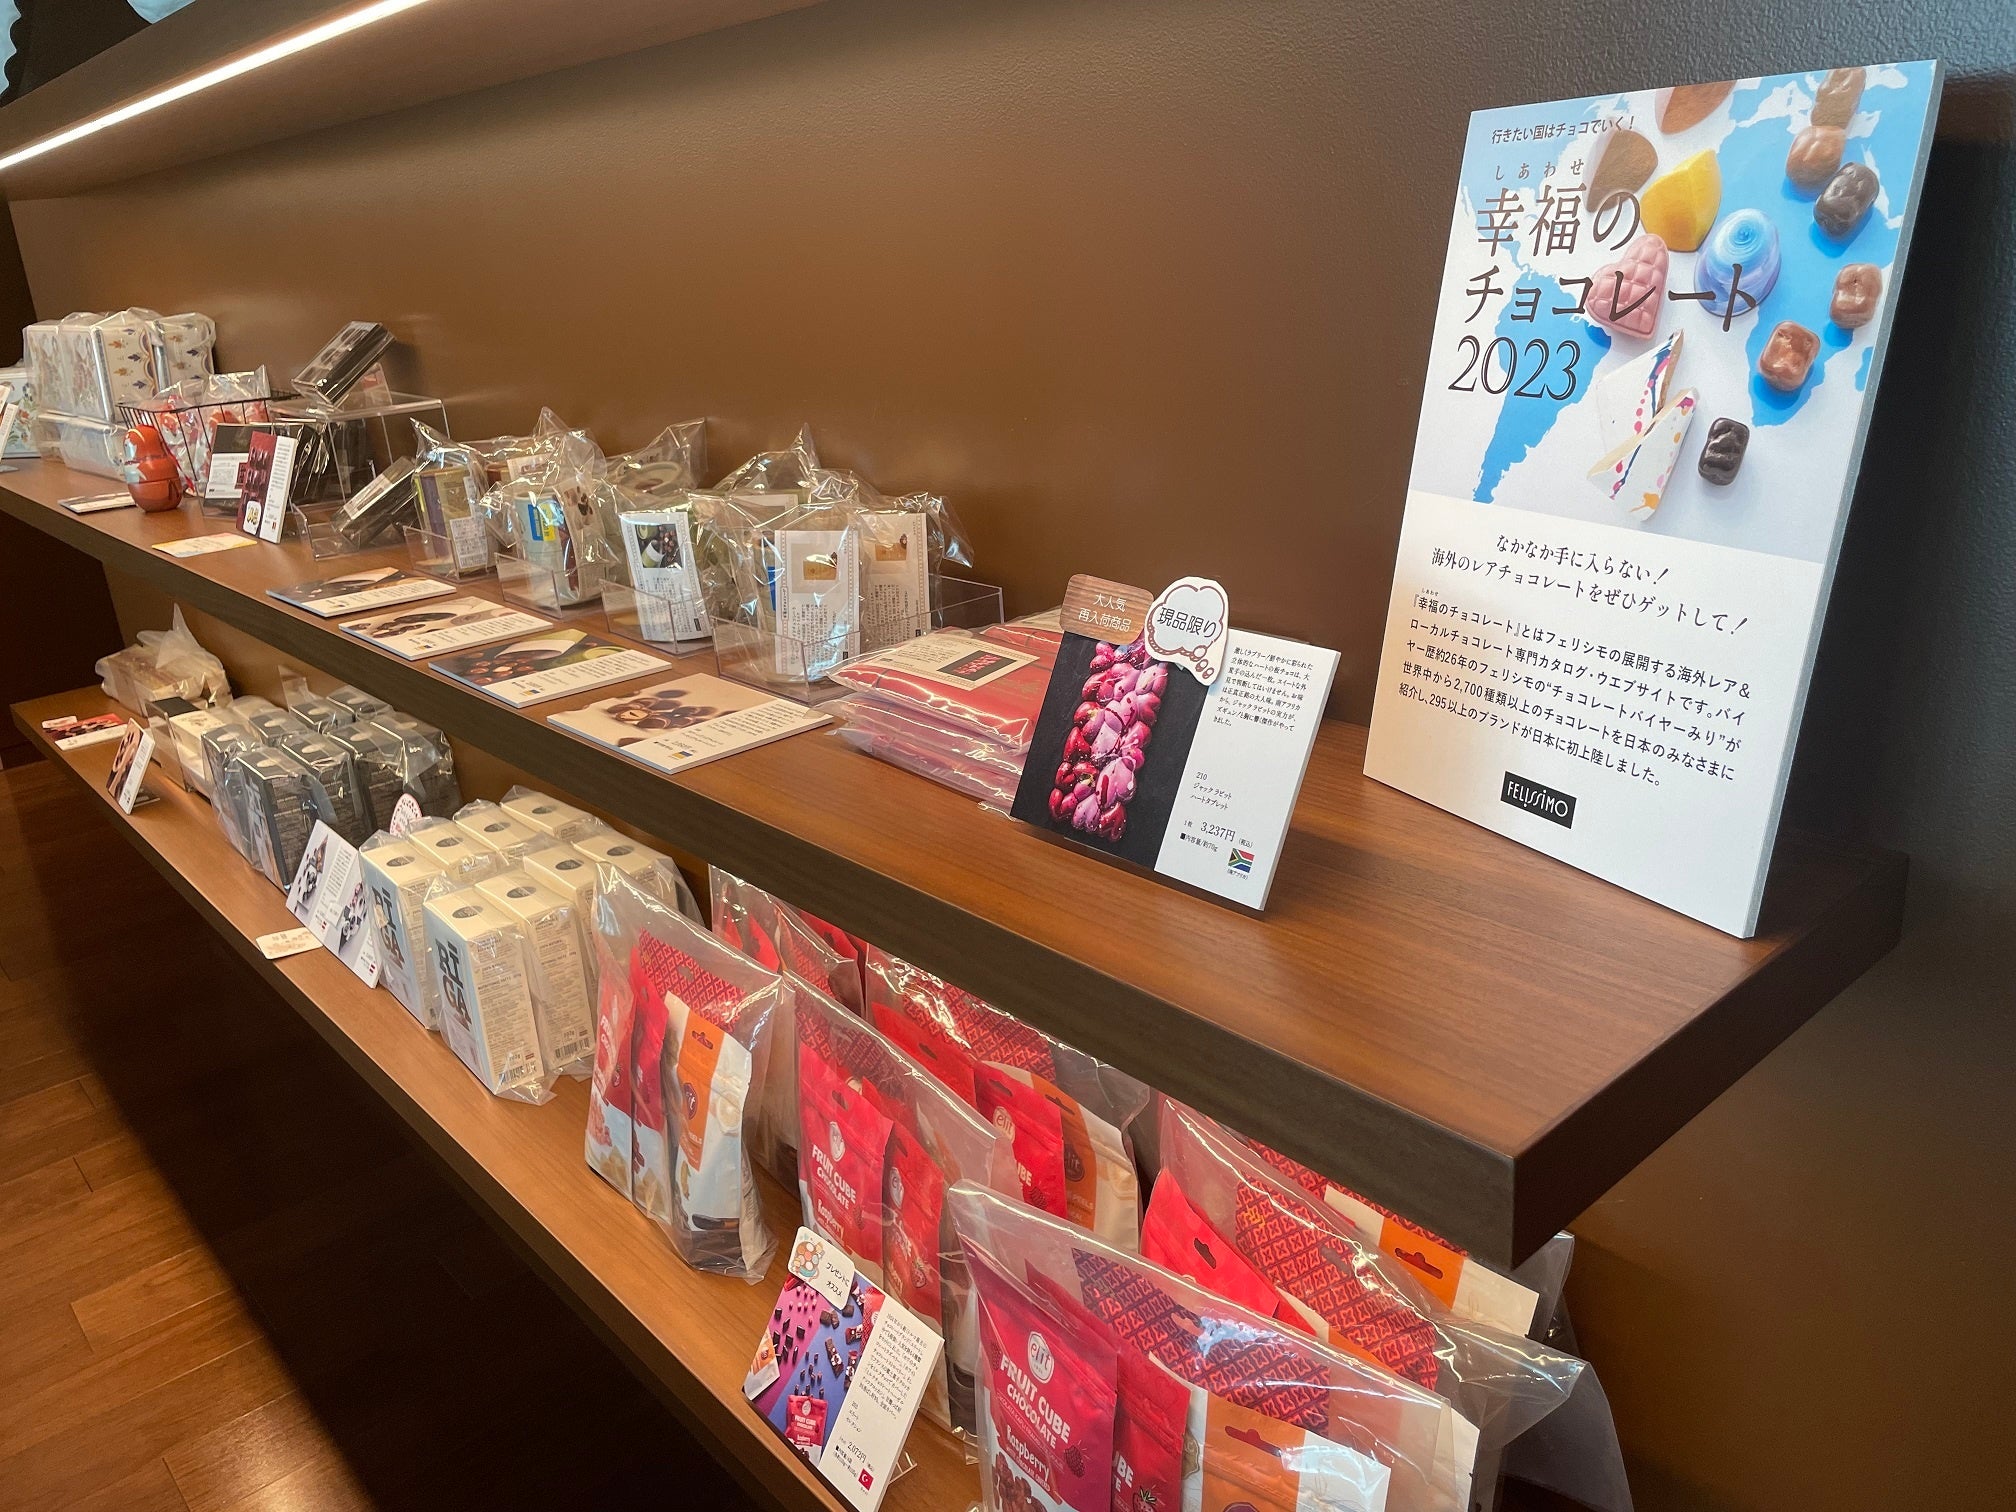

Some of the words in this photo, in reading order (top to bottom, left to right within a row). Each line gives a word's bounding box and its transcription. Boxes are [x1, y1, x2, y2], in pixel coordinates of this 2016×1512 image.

[1491, 115, 1636, 145] 行きたい国はチョコでいく！
[1476, 184, 1642, 258] 幸福の
[1464, 263, 1757, 334] チョコレート
[1448, 335, 1581, 400] 2023
[1496, 533, 1670, 585] なかなか手に入らない！
[1094, 593, 1127, 613] 大人気
[1431, 547, 1748, 635] 海外のレアチョコレートをぜひゲットして！
[1078, 607, 1132, 633] 再入荷商品
[1157, 606, 1218, 639] 現品限り
[1196, 772, 1208, 781] 210
[1200, 821, 1236, 843] 3,237円
[996, 1114, 1013, 1134] elit
[812, 1145, 834, 1178] FRUIT
[834, 1171, 857, 1204] CUBE
[817, 1167, 850, 1210] CHOCOLATE
[825, 1262, 850, 1288] プレゼントに
[1031, 1342, 1052, 1369] elit
[1000, 1355, 1038, 1399] FRUIT
[1038, 1396, 1071, 1444] CUBE
[1007, 1384, 1057, 1450] CHOCOLATE
[1006, 1425, 1050, 1482] Raspberry
